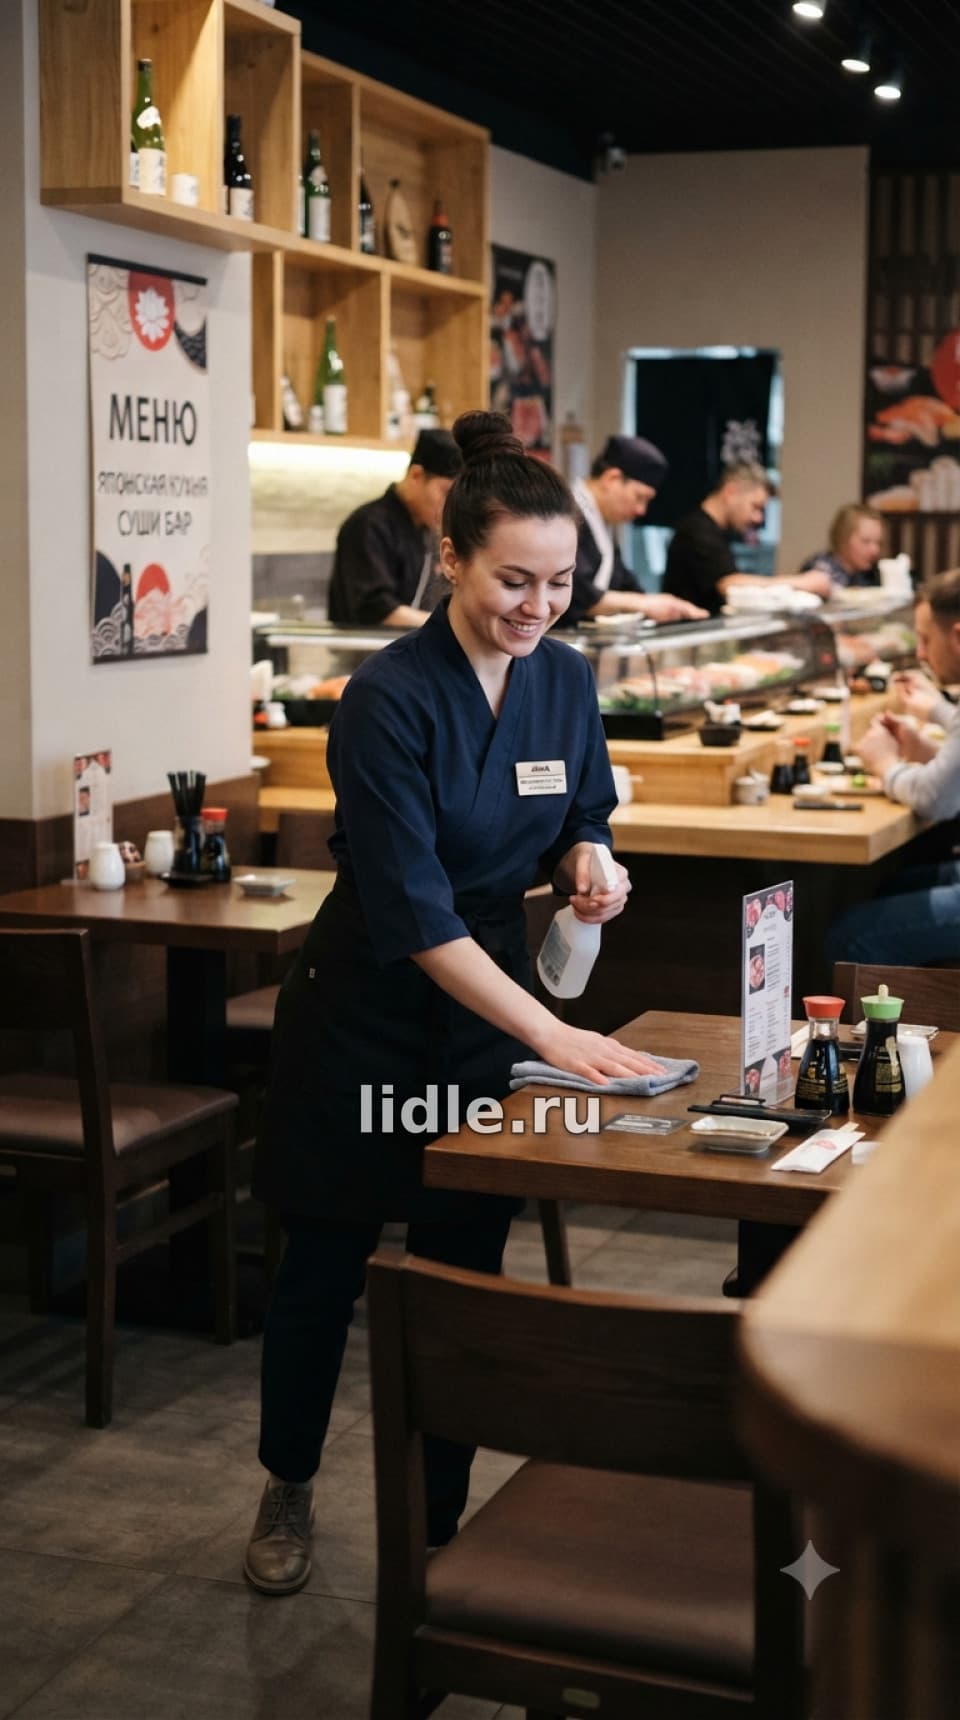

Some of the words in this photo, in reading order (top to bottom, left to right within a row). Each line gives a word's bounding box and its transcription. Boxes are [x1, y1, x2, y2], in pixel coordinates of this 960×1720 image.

[109, 393, 197, 446] МЕНЮ
[117, 509, 161, 536] СУШИ
[165, 510, 192, 537] БАР
